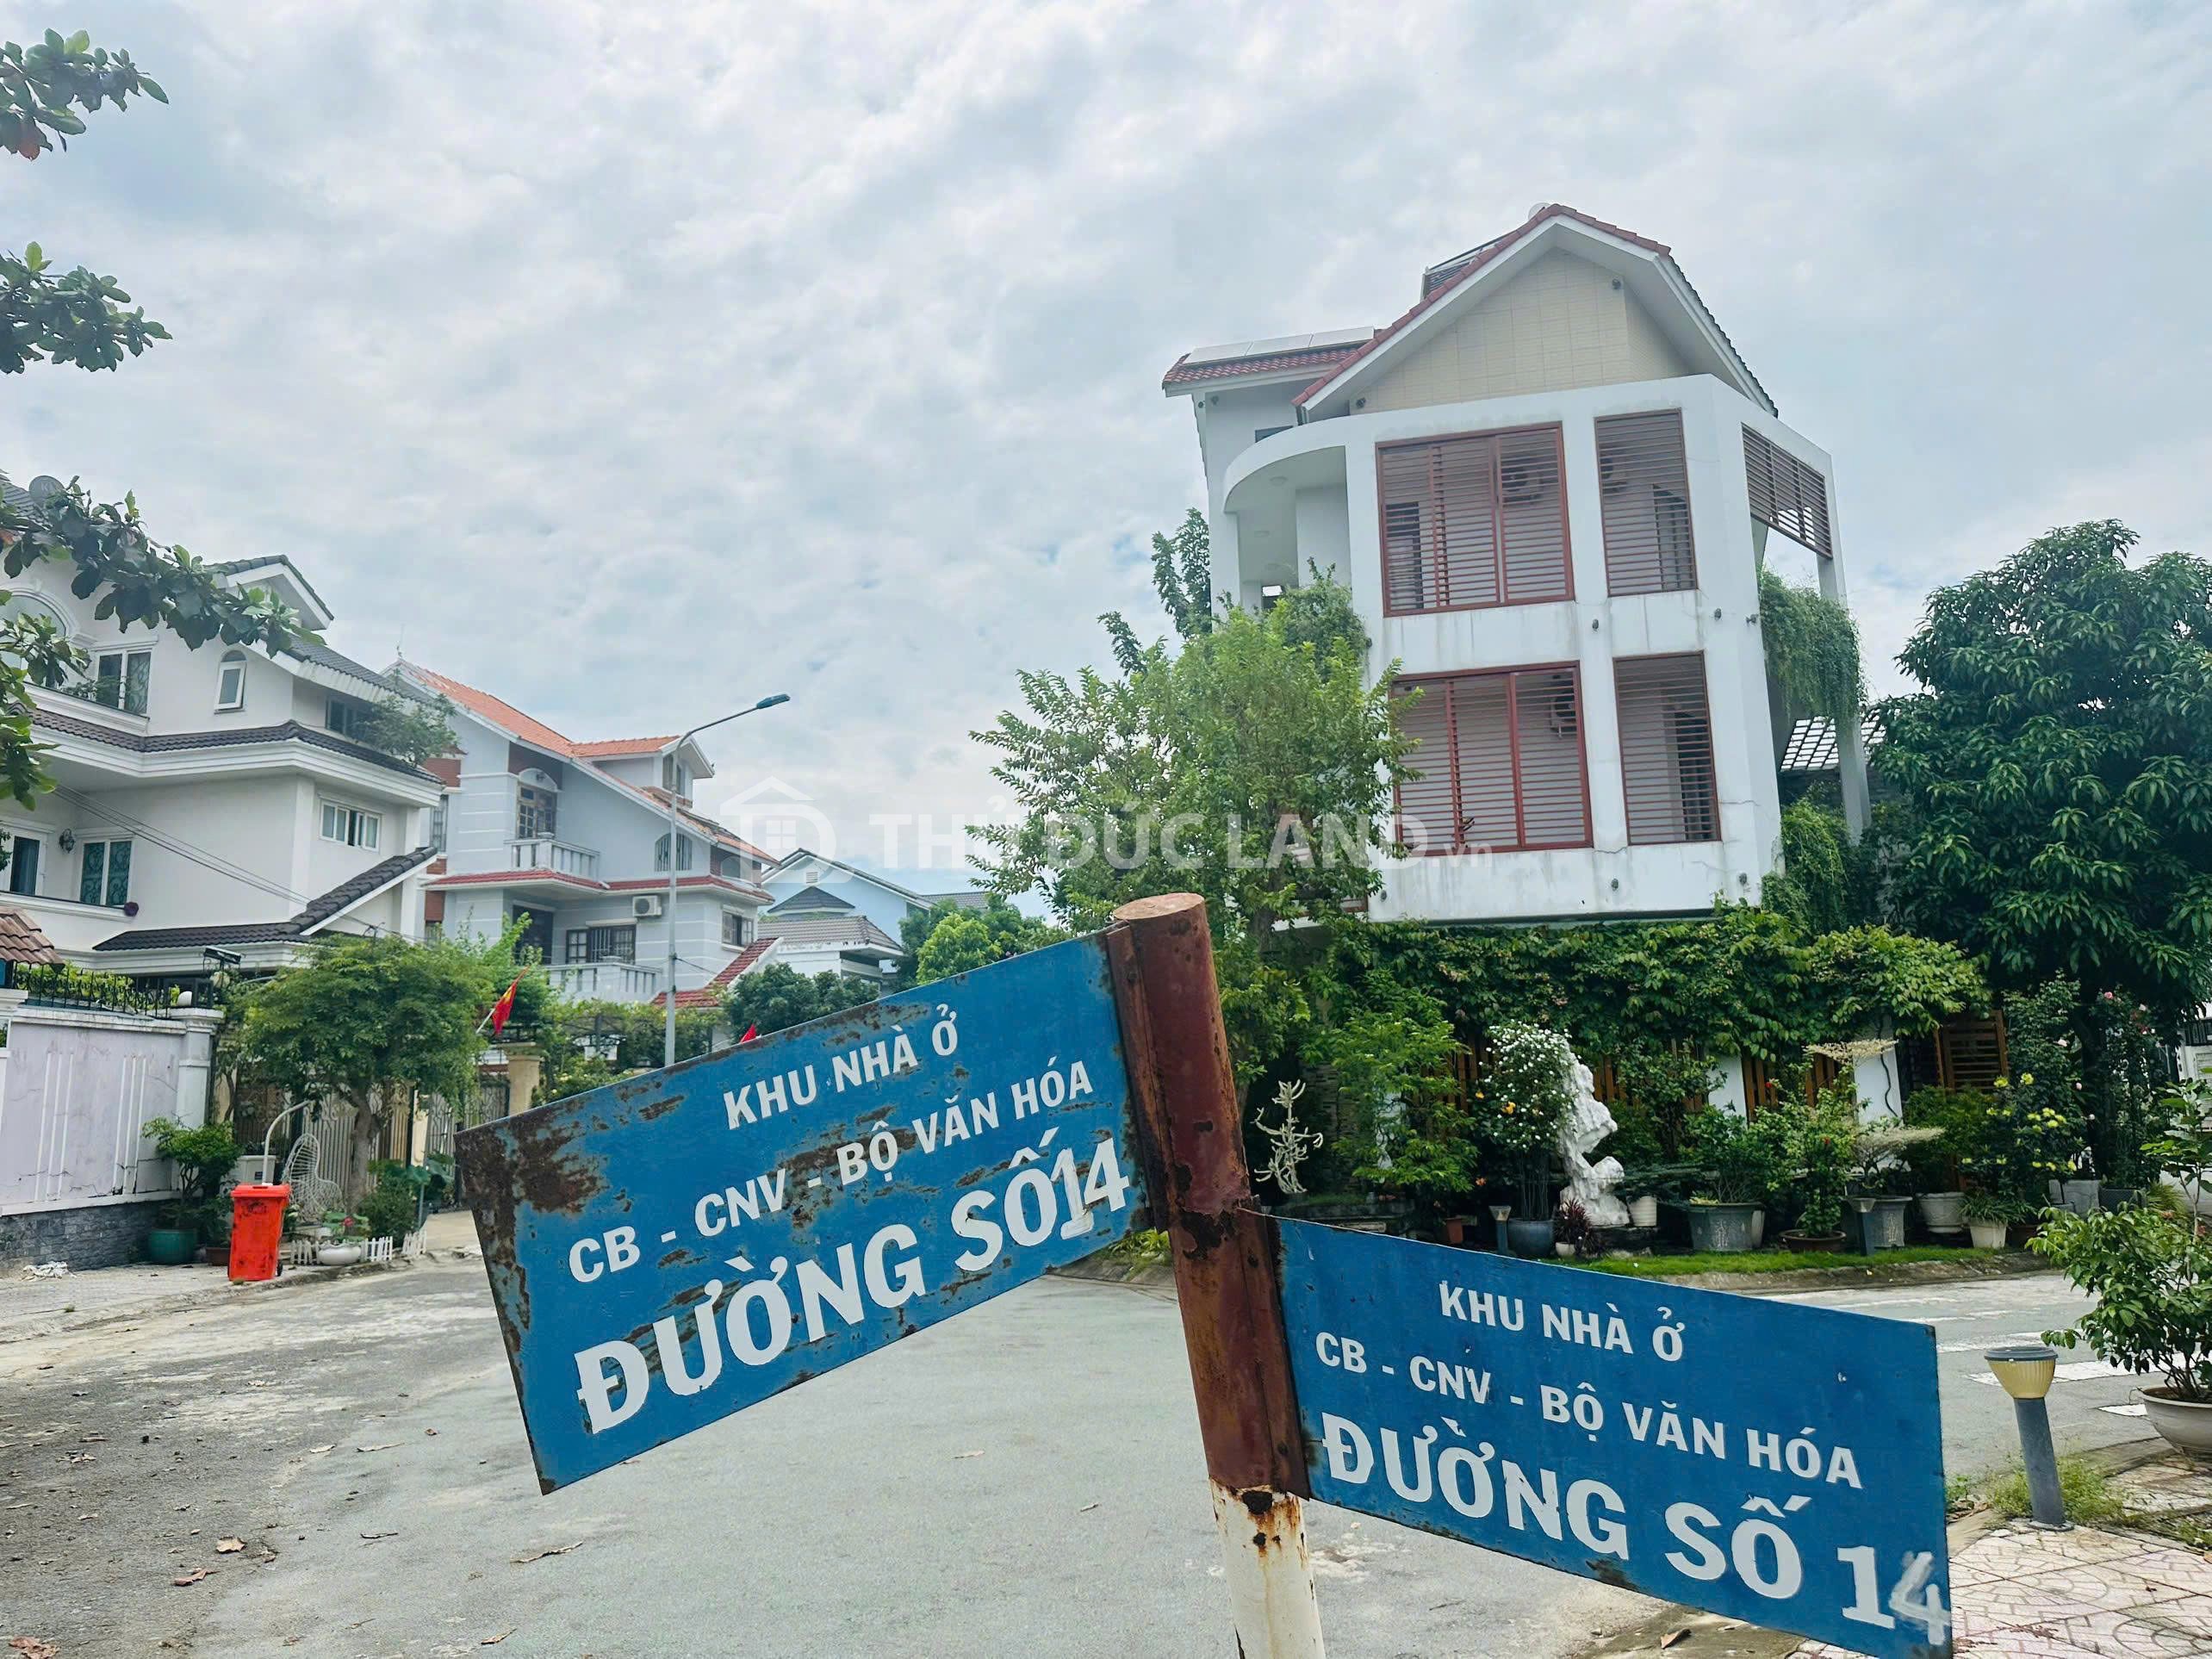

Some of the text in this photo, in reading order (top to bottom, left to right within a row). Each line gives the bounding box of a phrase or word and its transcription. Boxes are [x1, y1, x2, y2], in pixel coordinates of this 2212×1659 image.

[724, 1003, 959, 1129] KHU NHÀ Ở
[569, 1227, 640, 1283] CB
[696, 1168, 786, 1237] CNV
[836, 1121, 899, 1186] BỘ
[913, 1093, 999, 1153] VĂN
[1012, 1056, 1093, 1120] HÓA
[575, 1224, 926, 1434] ĐƯỜNG
[1316, 1332, 1367, 1373] CB
[1409, 1356, 1490, 1405] CNV
[1541, 1382, 1604, 1442] BỘ
[1623, 1401, 1725, 1459] VĂN
[1747, 1426, 1862, 1488] HÓA
[1439, 1282, 1685, 1362] KHU NHÀ Ở
[1321, 1413, 1950, 1646] ĐƯỜNG SỐ 14
